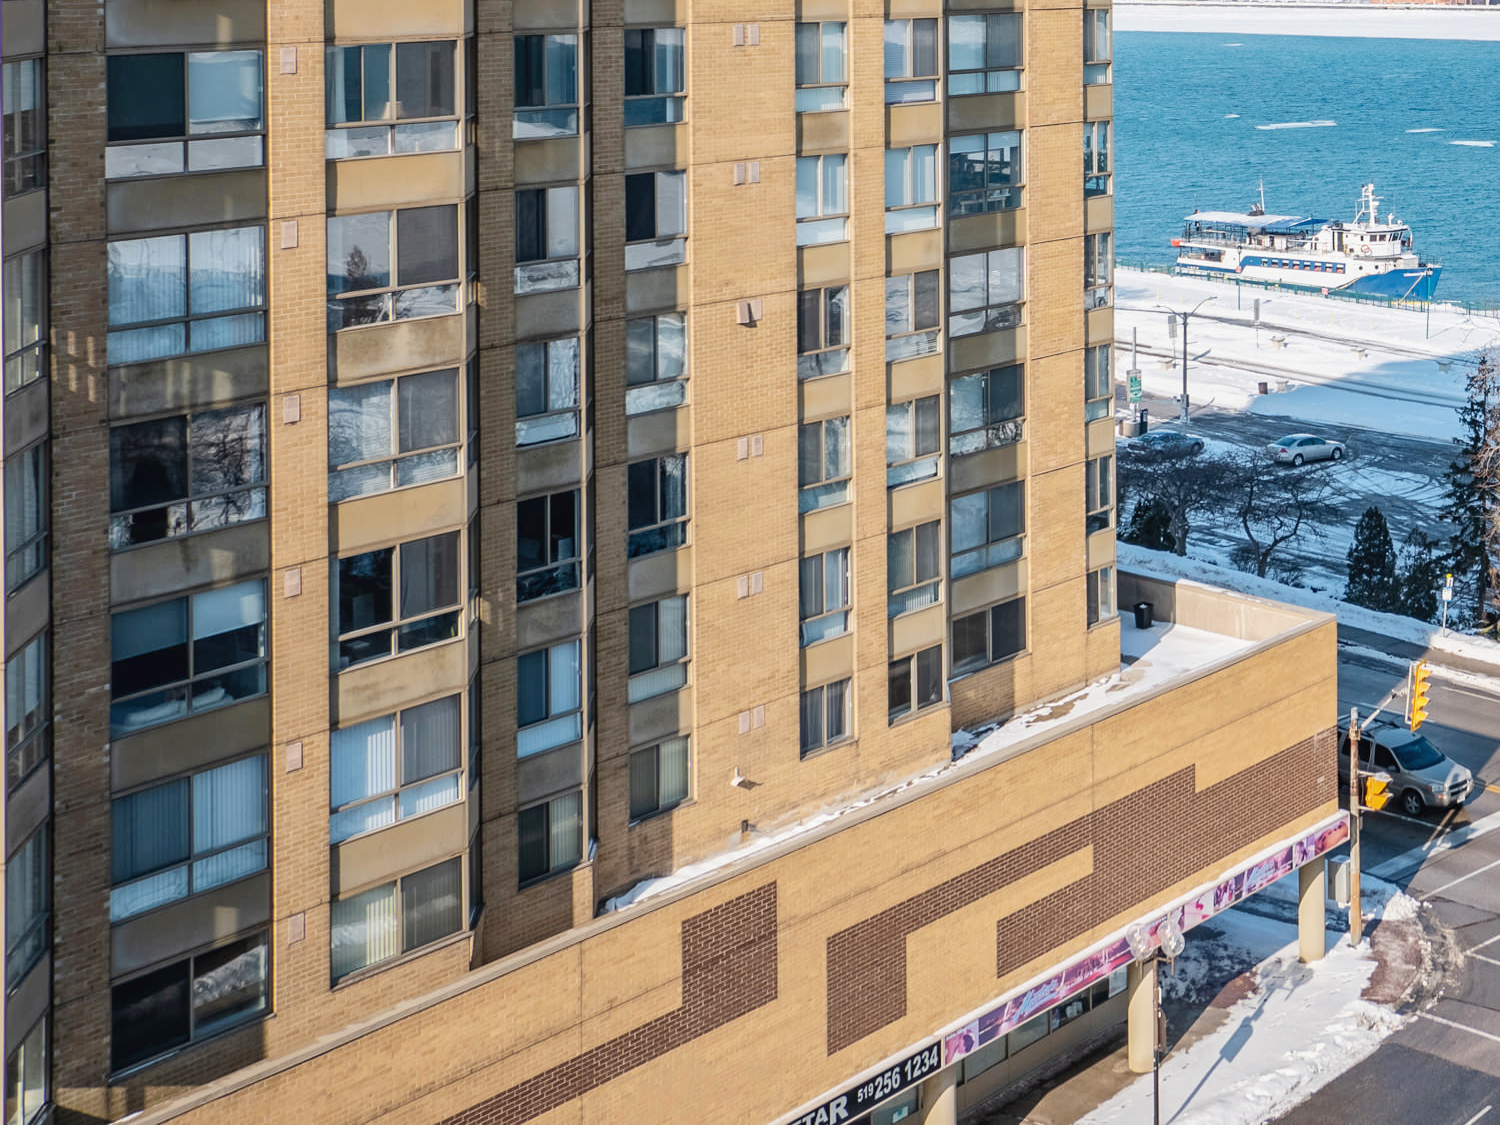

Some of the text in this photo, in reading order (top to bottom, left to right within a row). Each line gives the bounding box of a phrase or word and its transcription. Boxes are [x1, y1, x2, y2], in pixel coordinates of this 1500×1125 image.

[791, 1044, 939, 1125] TAR 519 256 1234
